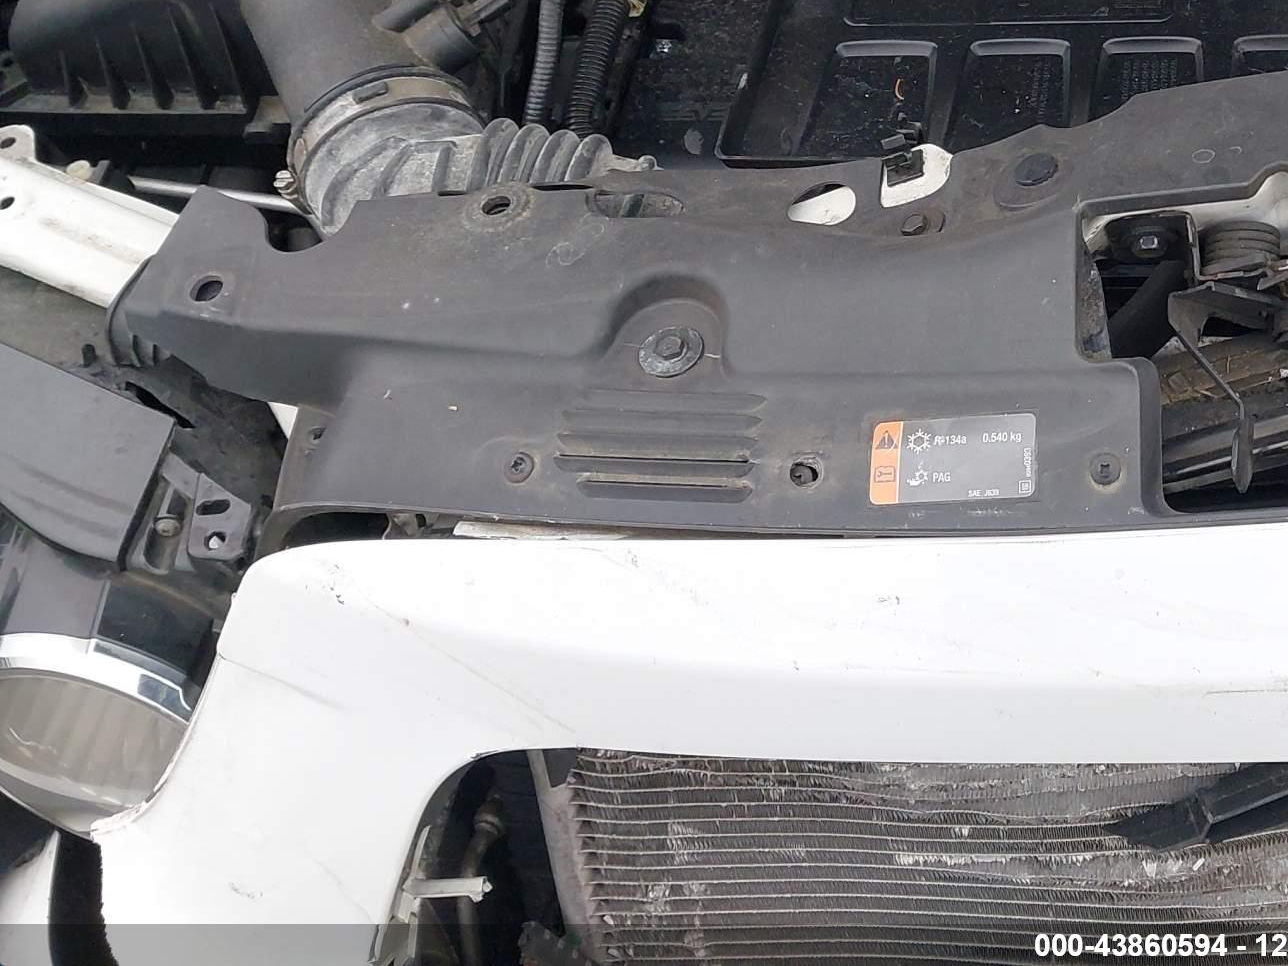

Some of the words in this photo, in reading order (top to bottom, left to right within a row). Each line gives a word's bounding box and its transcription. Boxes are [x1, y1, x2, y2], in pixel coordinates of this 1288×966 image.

[933, 434, 967, 445] R-134a
[982, 432, 1008, 443] 0.540
[1009, 431, 1022, 443] kg
[932, 472, 951, 483] PAG
